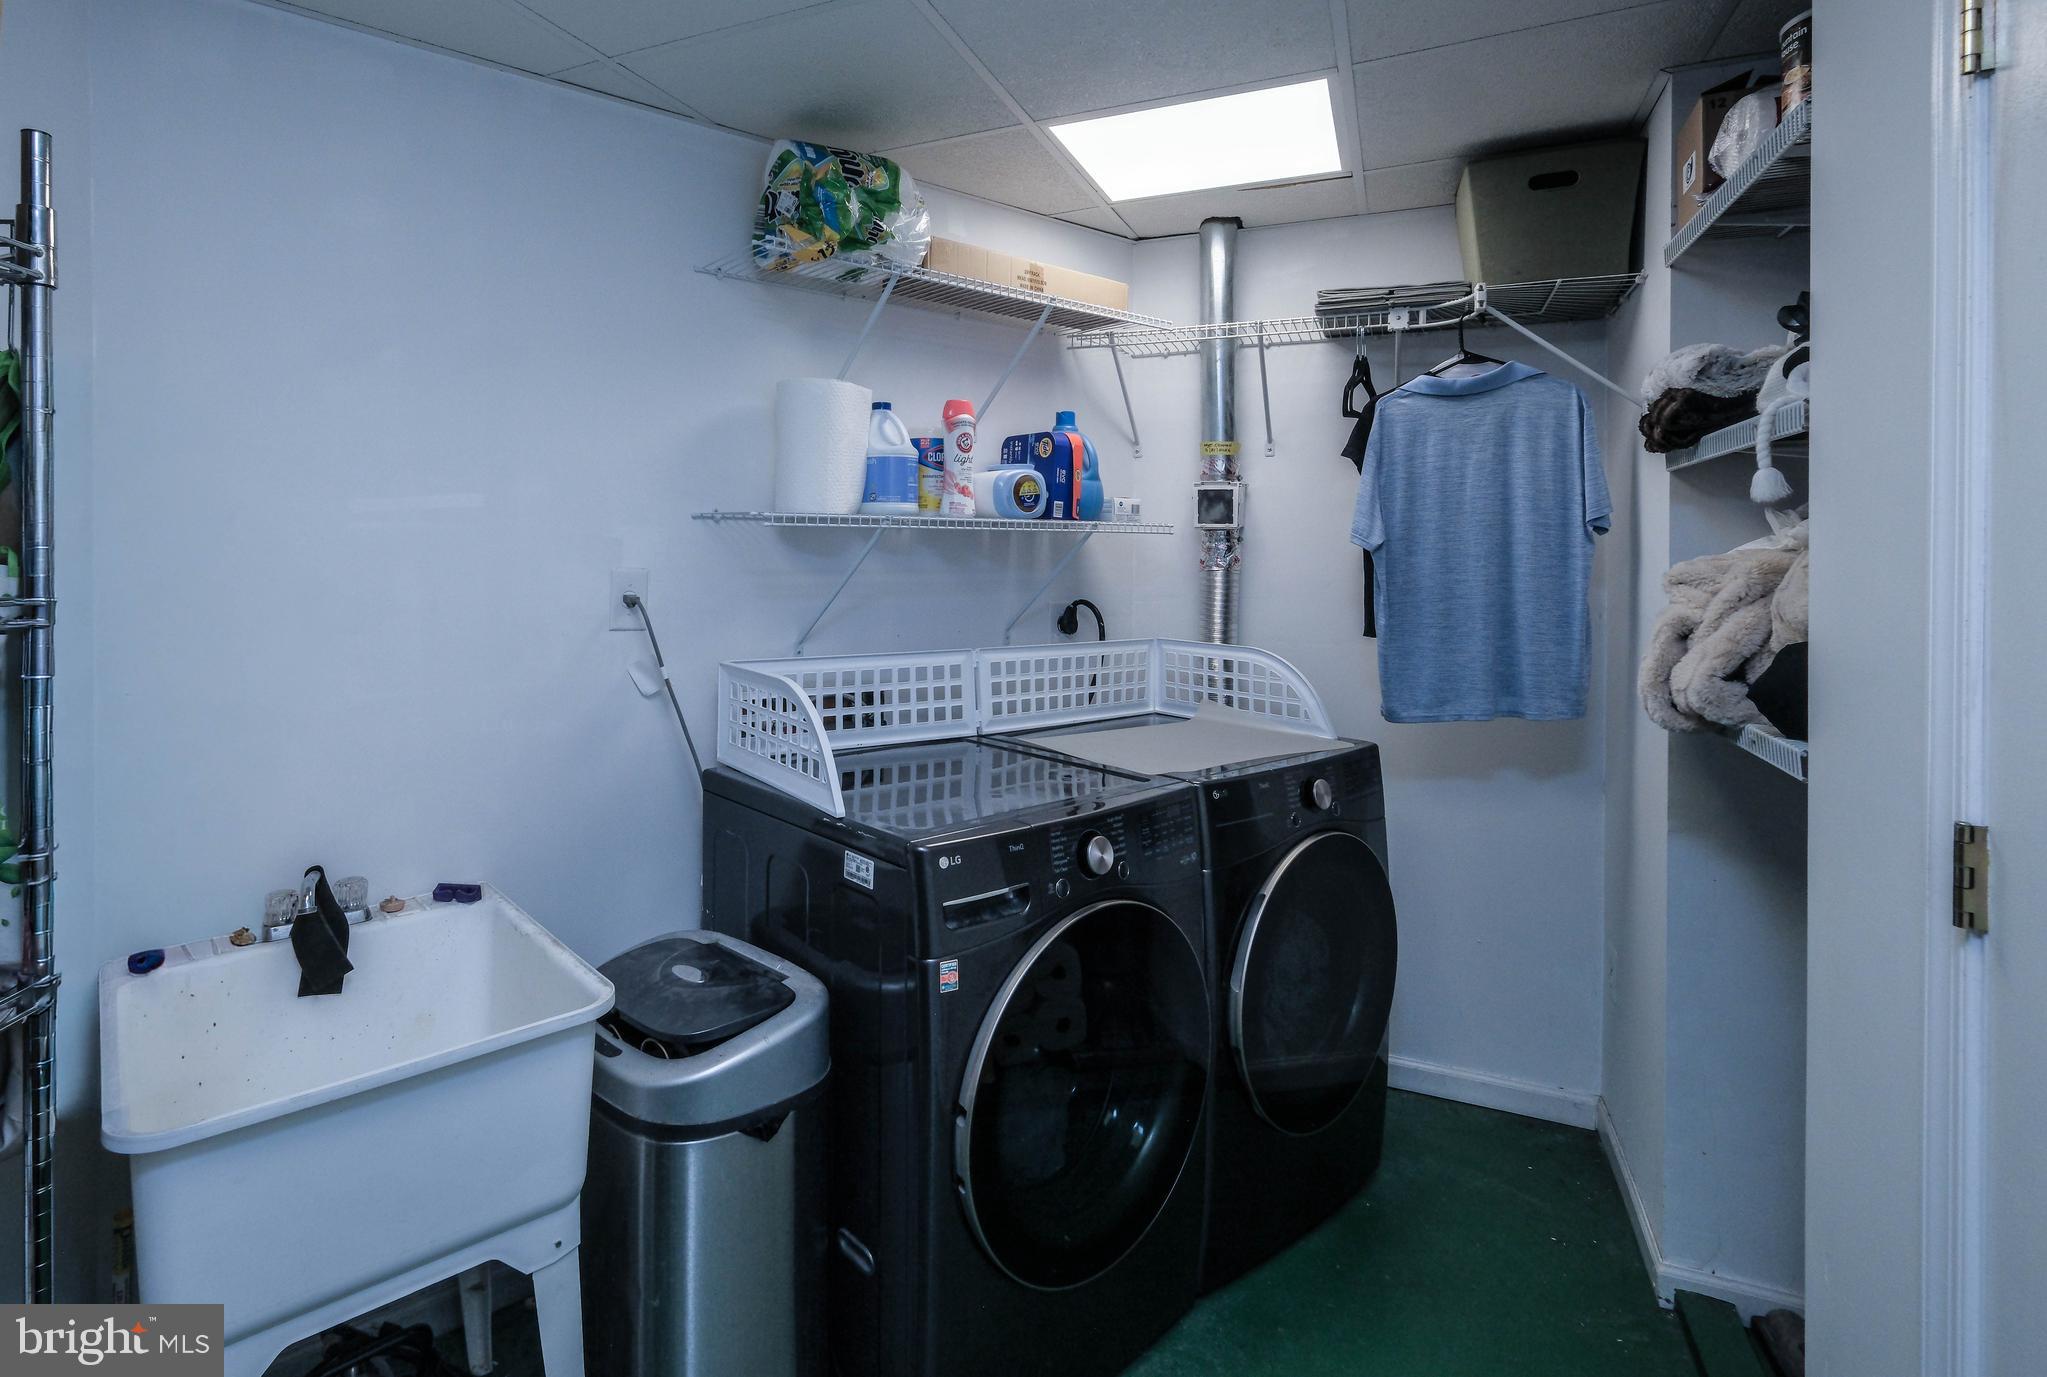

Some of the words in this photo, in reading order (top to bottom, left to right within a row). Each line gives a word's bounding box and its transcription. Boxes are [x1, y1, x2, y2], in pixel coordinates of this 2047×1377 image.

[1041, 438, 1050, 456] Tide
[953, 453, 973, 467] light
[1009, 843, 1025, 852] ThinQ
[950, 855, 962, 866] LG
